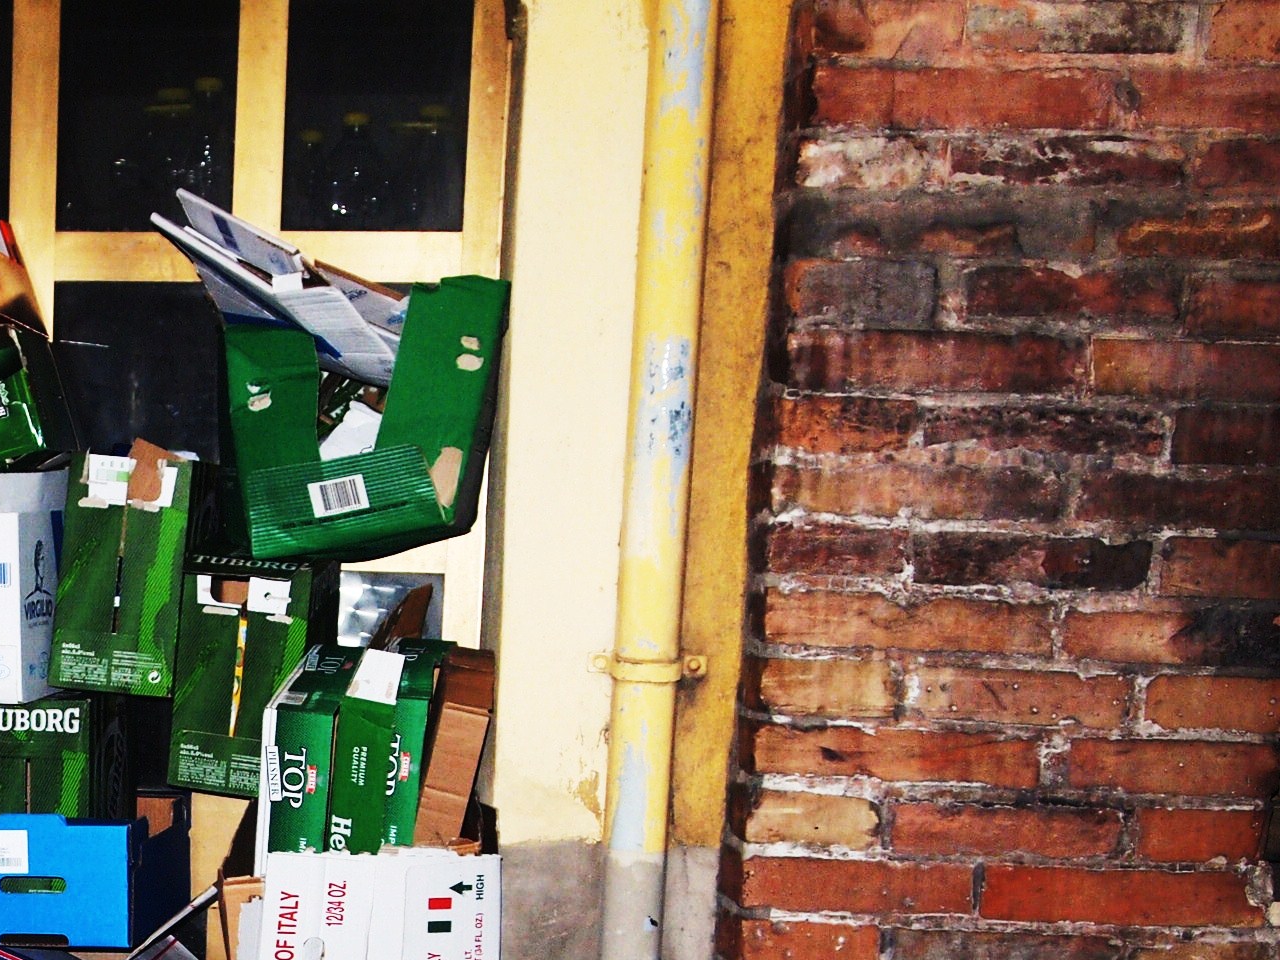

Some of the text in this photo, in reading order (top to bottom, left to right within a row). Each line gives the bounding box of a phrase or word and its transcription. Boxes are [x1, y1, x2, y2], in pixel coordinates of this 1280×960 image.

[192, 554, 296, 571] TUBORG
[24, 599, 54, 620] VIRGILIO
[283, 748, 307, 808] TOP
[351, 747, 360, 784] QUALITY
[358, 746, 368, 786] PREMIUM
[325, 880, 347, 927] 12/34 OZ.
[475, 874, 485, 901] HIGH
[277, 891, 299, 935] ITALY
